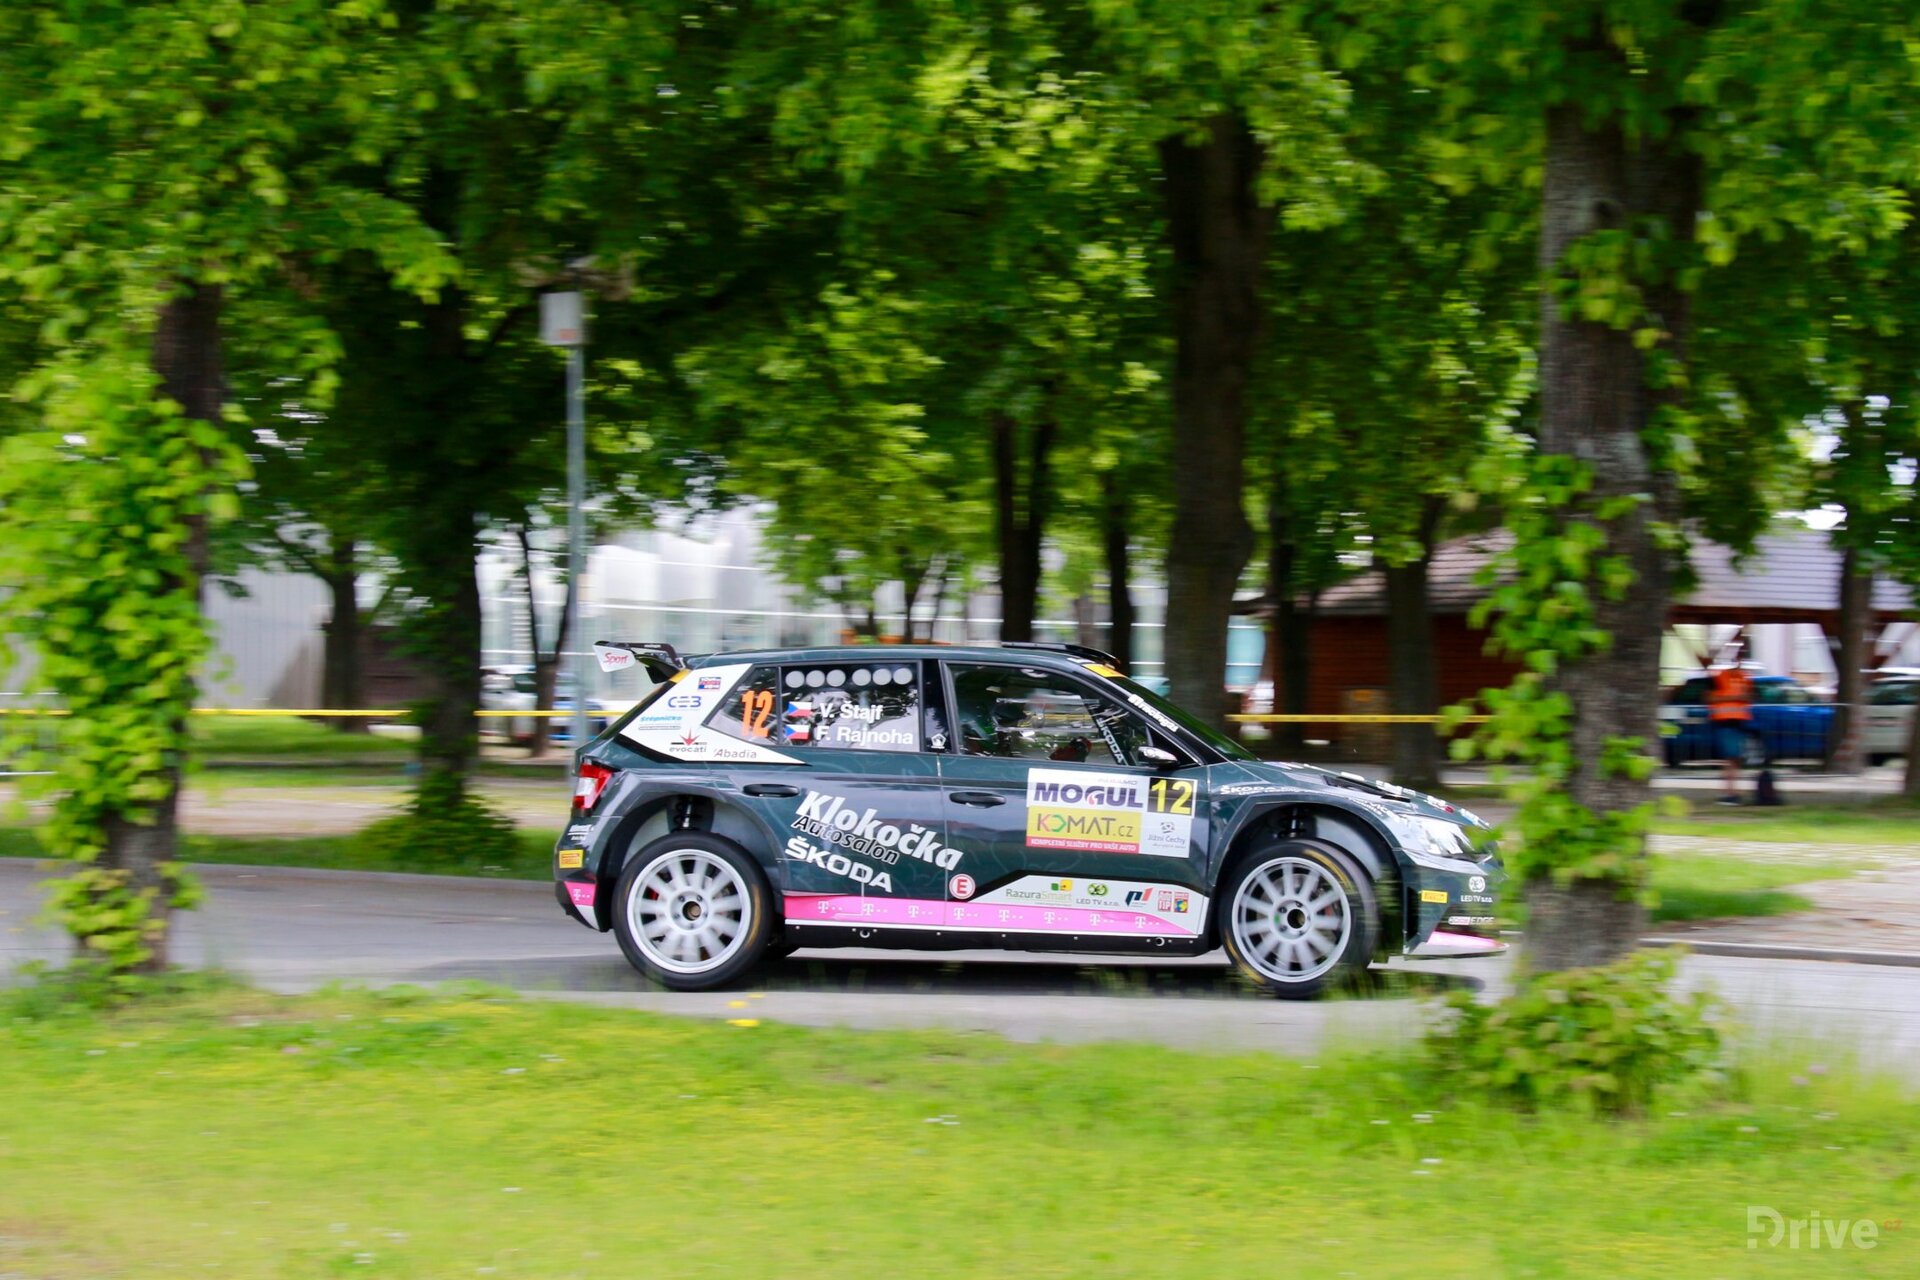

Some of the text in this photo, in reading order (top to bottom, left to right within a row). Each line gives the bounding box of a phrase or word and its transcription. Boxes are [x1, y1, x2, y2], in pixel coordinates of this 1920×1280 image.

[603, 652, 629, 665] Sport
[741, 690, 773, 738] 12
[819, 700, 884, 724] V. Štajf
[815, 725, 914, 745] F. Rajnoha
[669, 745, 707, 753] evocati
[1034, 782, 1144, 809] MOGUL
[1151, 778, 1192, 815] 12
[791, 815, 899, 865] Autosalon
[795, 790, 964, 871] Klokočka
[784, 836, 892, 893] ŠKODA
[956, 879, 968, 894] E
